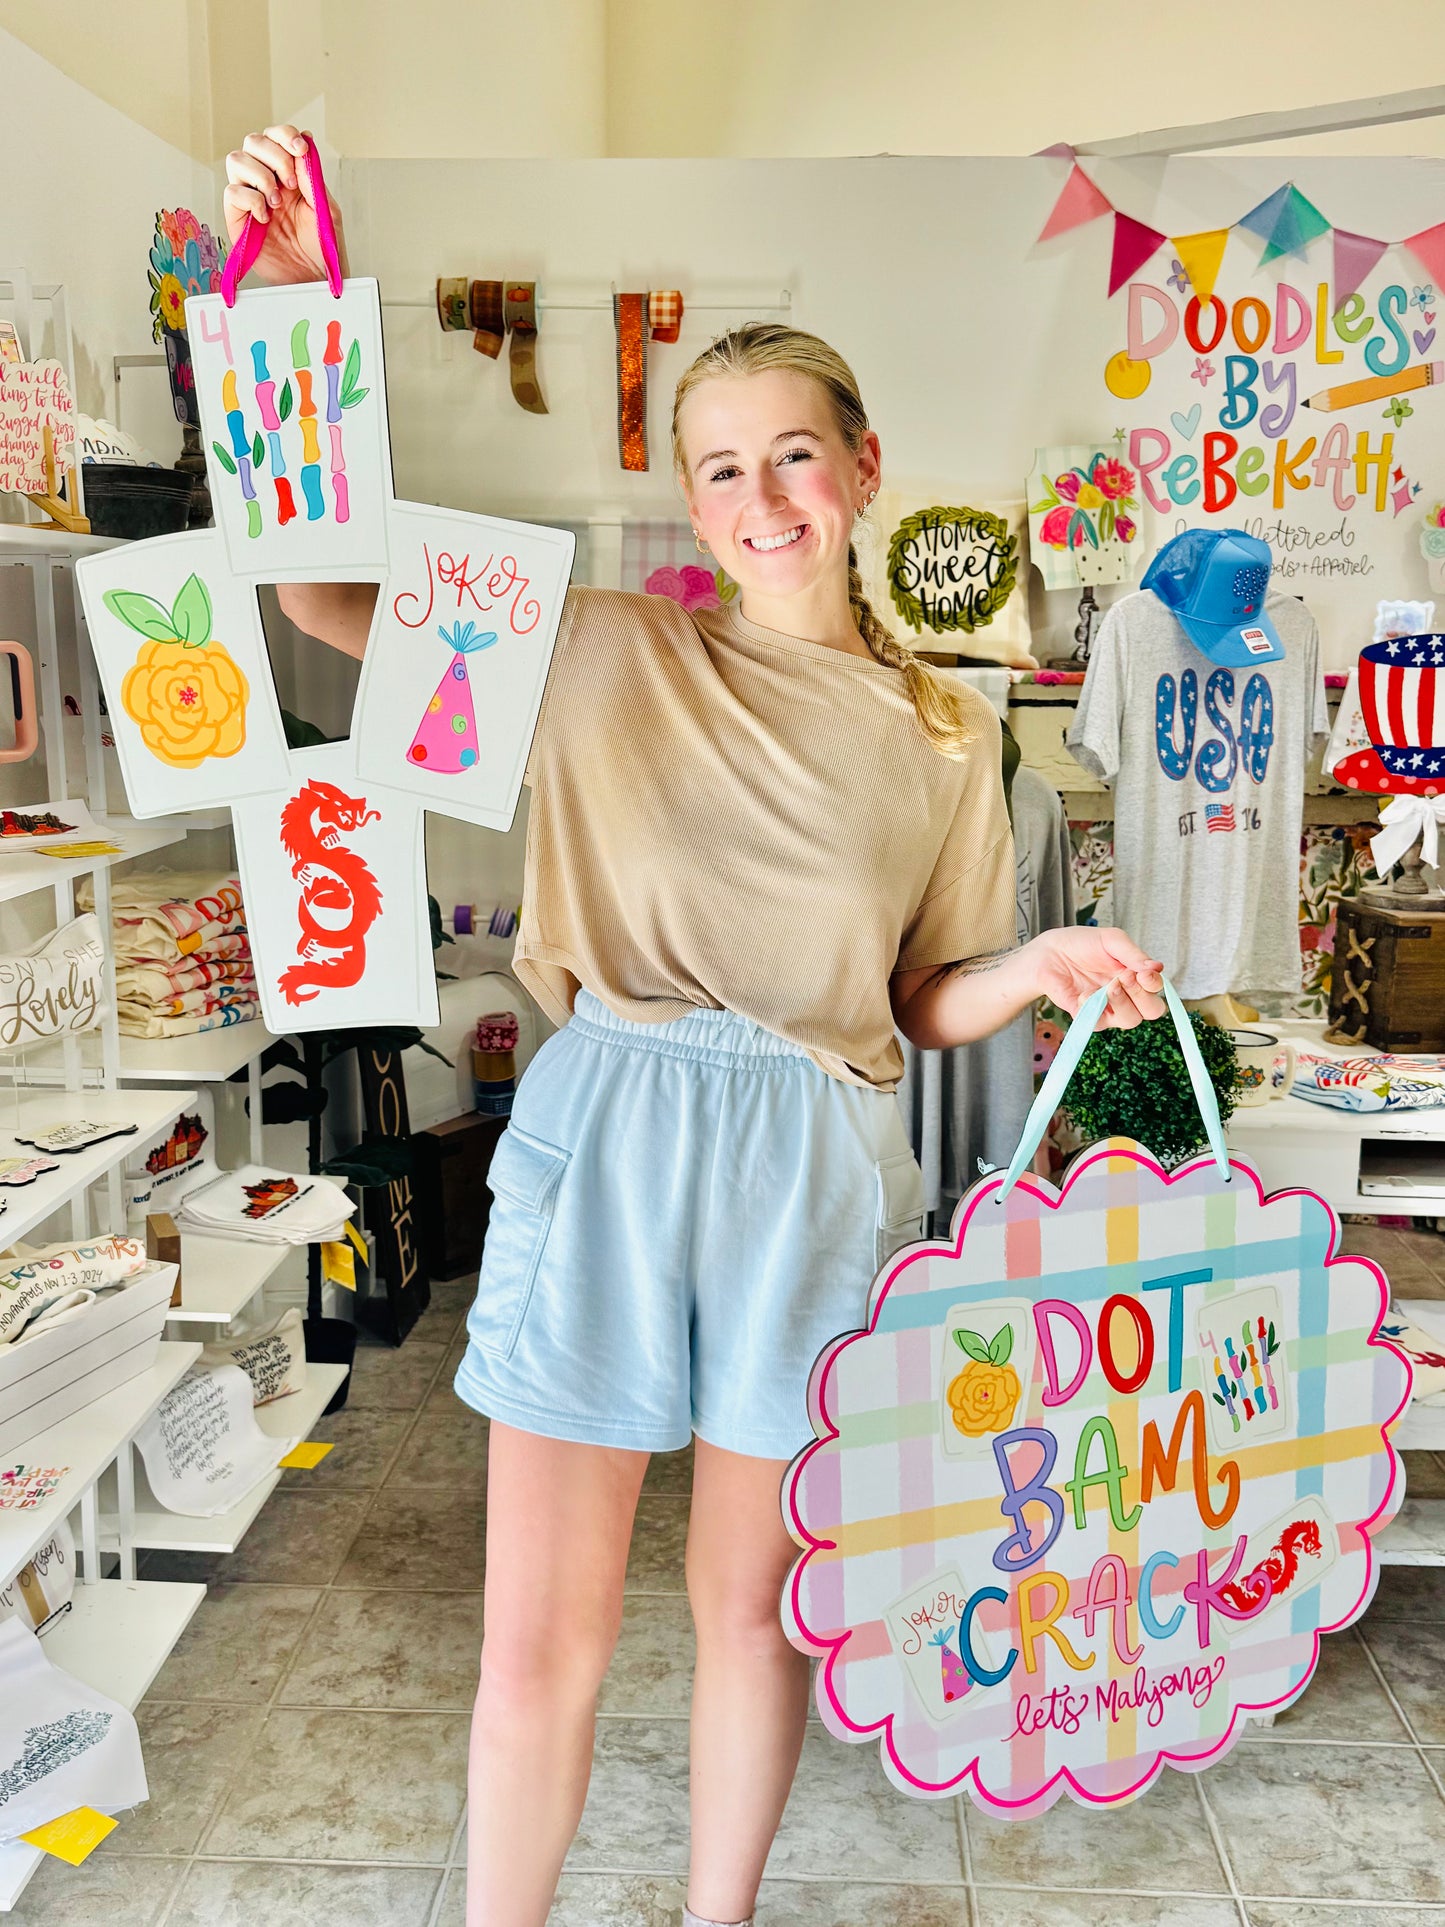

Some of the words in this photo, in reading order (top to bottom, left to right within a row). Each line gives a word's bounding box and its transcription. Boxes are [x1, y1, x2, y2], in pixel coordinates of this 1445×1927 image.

[200, 309, 234, 365] 4
[0, 385, 32, 412] ling
[51, 388, 73, 412] the
[16, 475, 48, 492] crow
[893, 538, 1012, 592] Sweet
[1155, 667, 1274, 793] USA
[0, 962, 102, 1044] Lovely
[82, 1269, 103, 1284] 2024
[1032, 1268, 1213, 1407] DOT
[992, 1389, 1240, 1572] BAM
[959, 1535, 1272, 1686] CRACK
[1096, 1656, 1225, 1727] Mahjong
